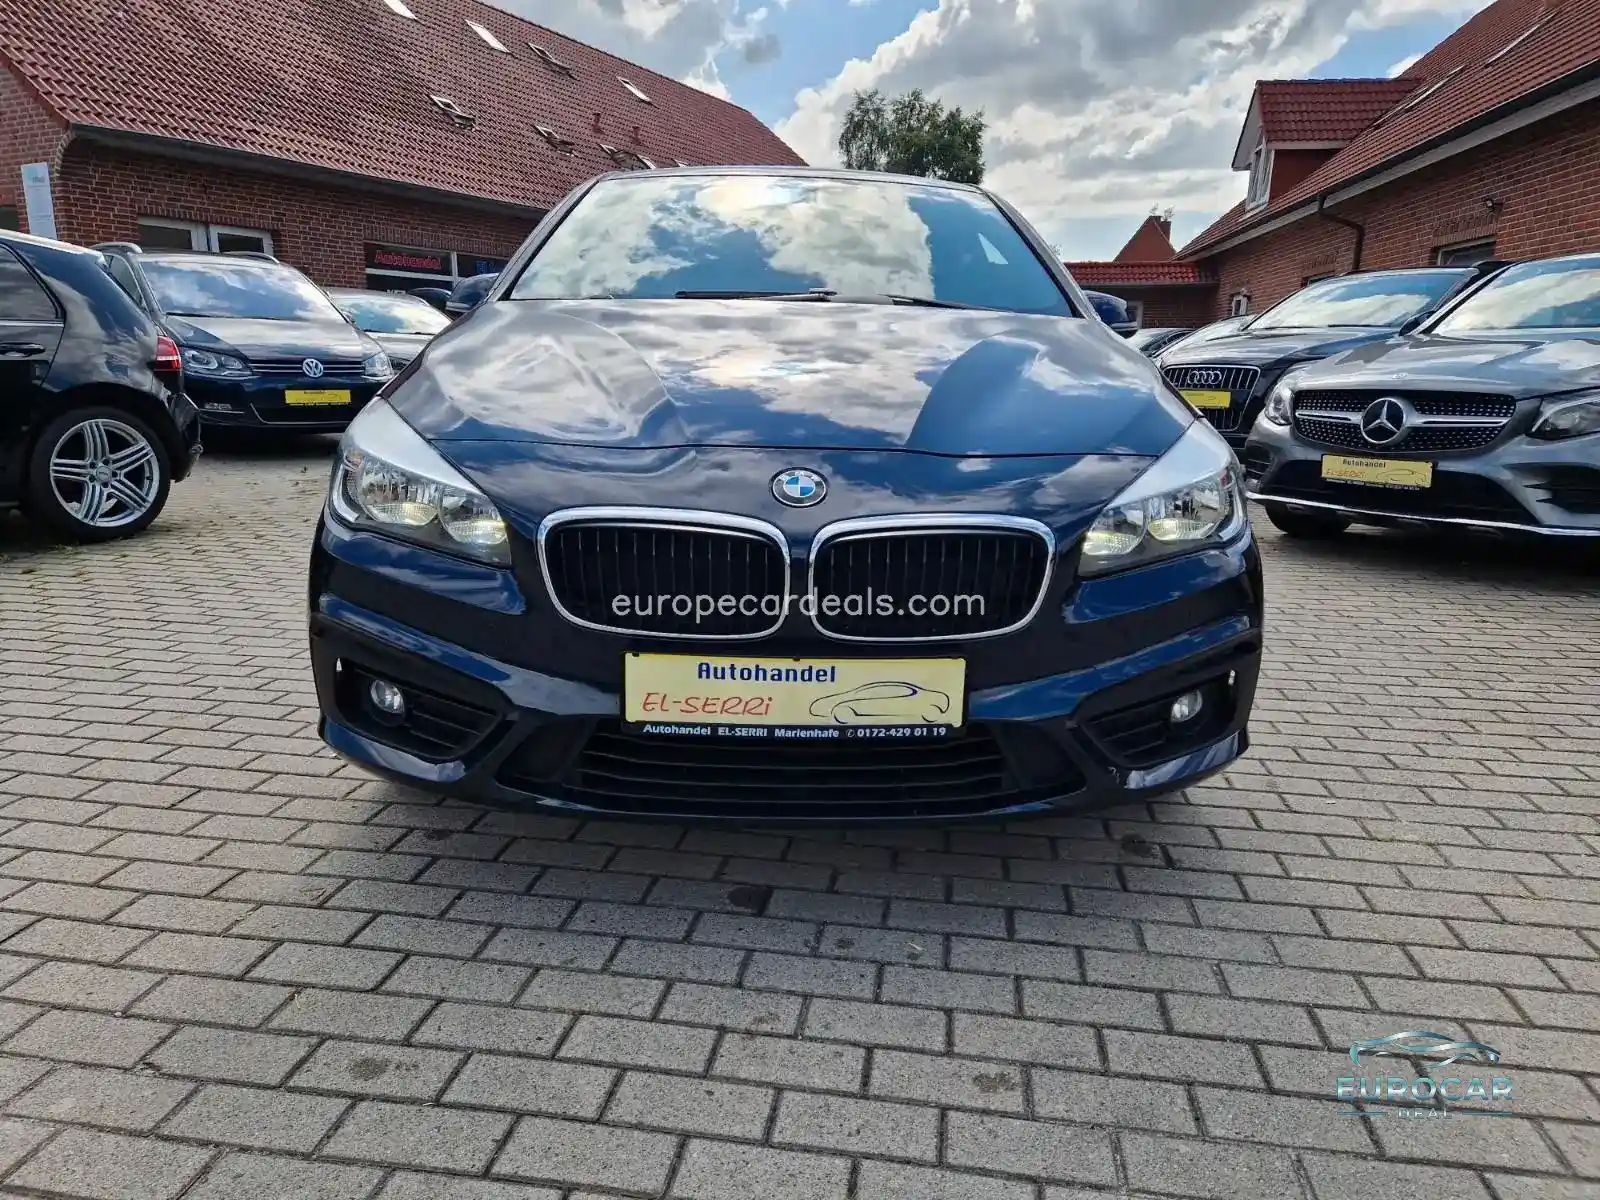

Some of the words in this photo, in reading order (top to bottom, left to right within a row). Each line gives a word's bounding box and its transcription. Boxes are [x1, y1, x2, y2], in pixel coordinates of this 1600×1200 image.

[1342, 459, 1386, 468] Autohandel
[697, 662, 836, 683] Autohandel
[643, 724, 711, 736] Autohandel
[718, 728, 768, 737] EL-SERRI
[774, 728, 839, 738] Marienhafe
[857, 728, 911, 737] 0172-429
[914, 727, 927, 736] 01
[933, 727, 946, 736] 19
